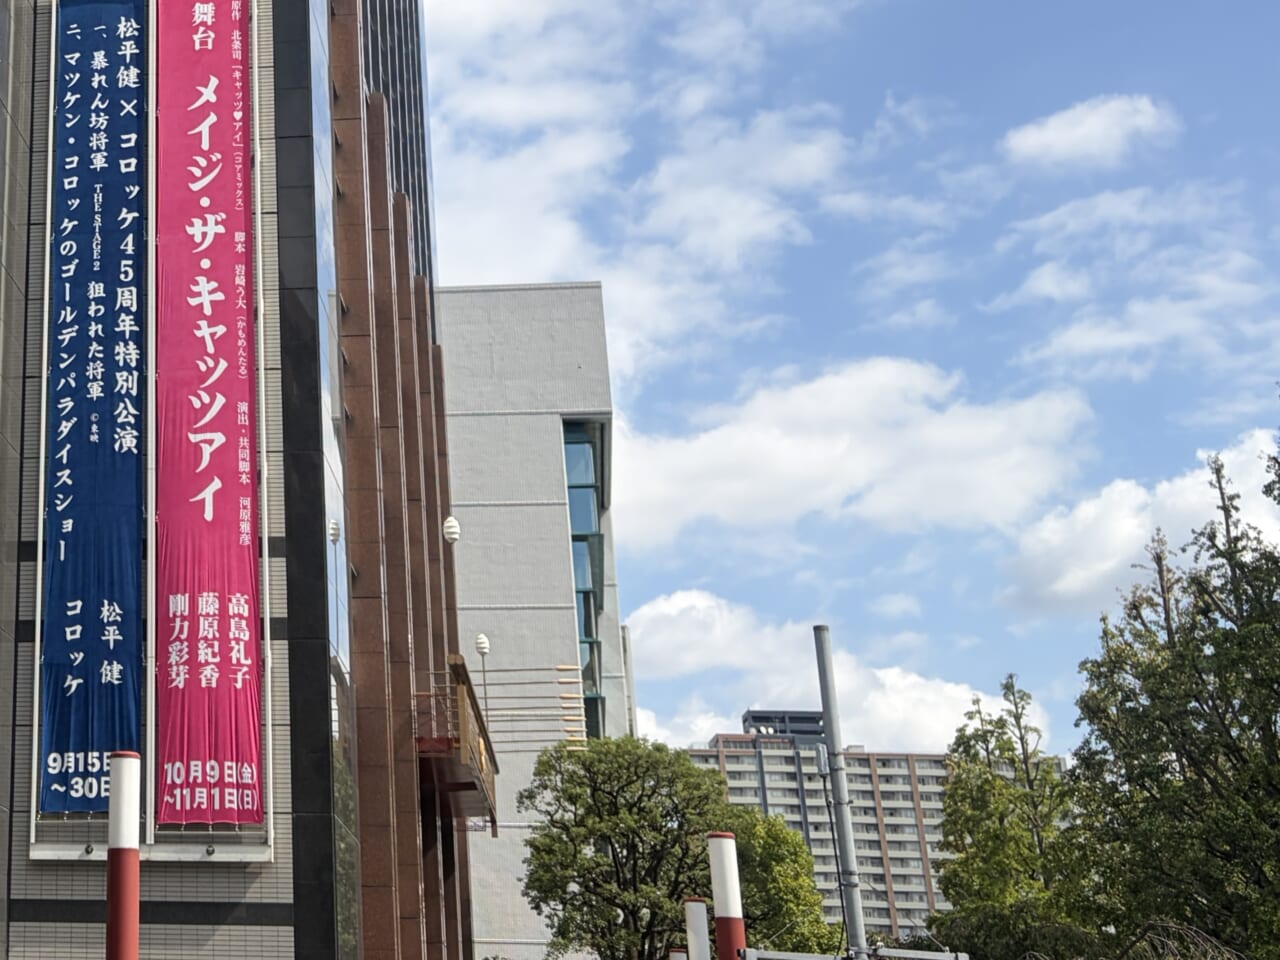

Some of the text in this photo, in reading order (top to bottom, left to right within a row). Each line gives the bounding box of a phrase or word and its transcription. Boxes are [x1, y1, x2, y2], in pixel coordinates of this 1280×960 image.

[192, 2, 216, 51] 舞台
[92, 213, 102, 260] STAGE
[93, 183, 103, 212] THE
[93, 260, 100, 271] 2
[85, 280, 106, 401] 狙われた将軍
[64, 599, 84, 696] コロッケ
[168, 593, 189, 689] 剛力彩芽
[197, 591, 221, 688] 藤原紀香
[228, 592, 252, 689] 高島礼子
